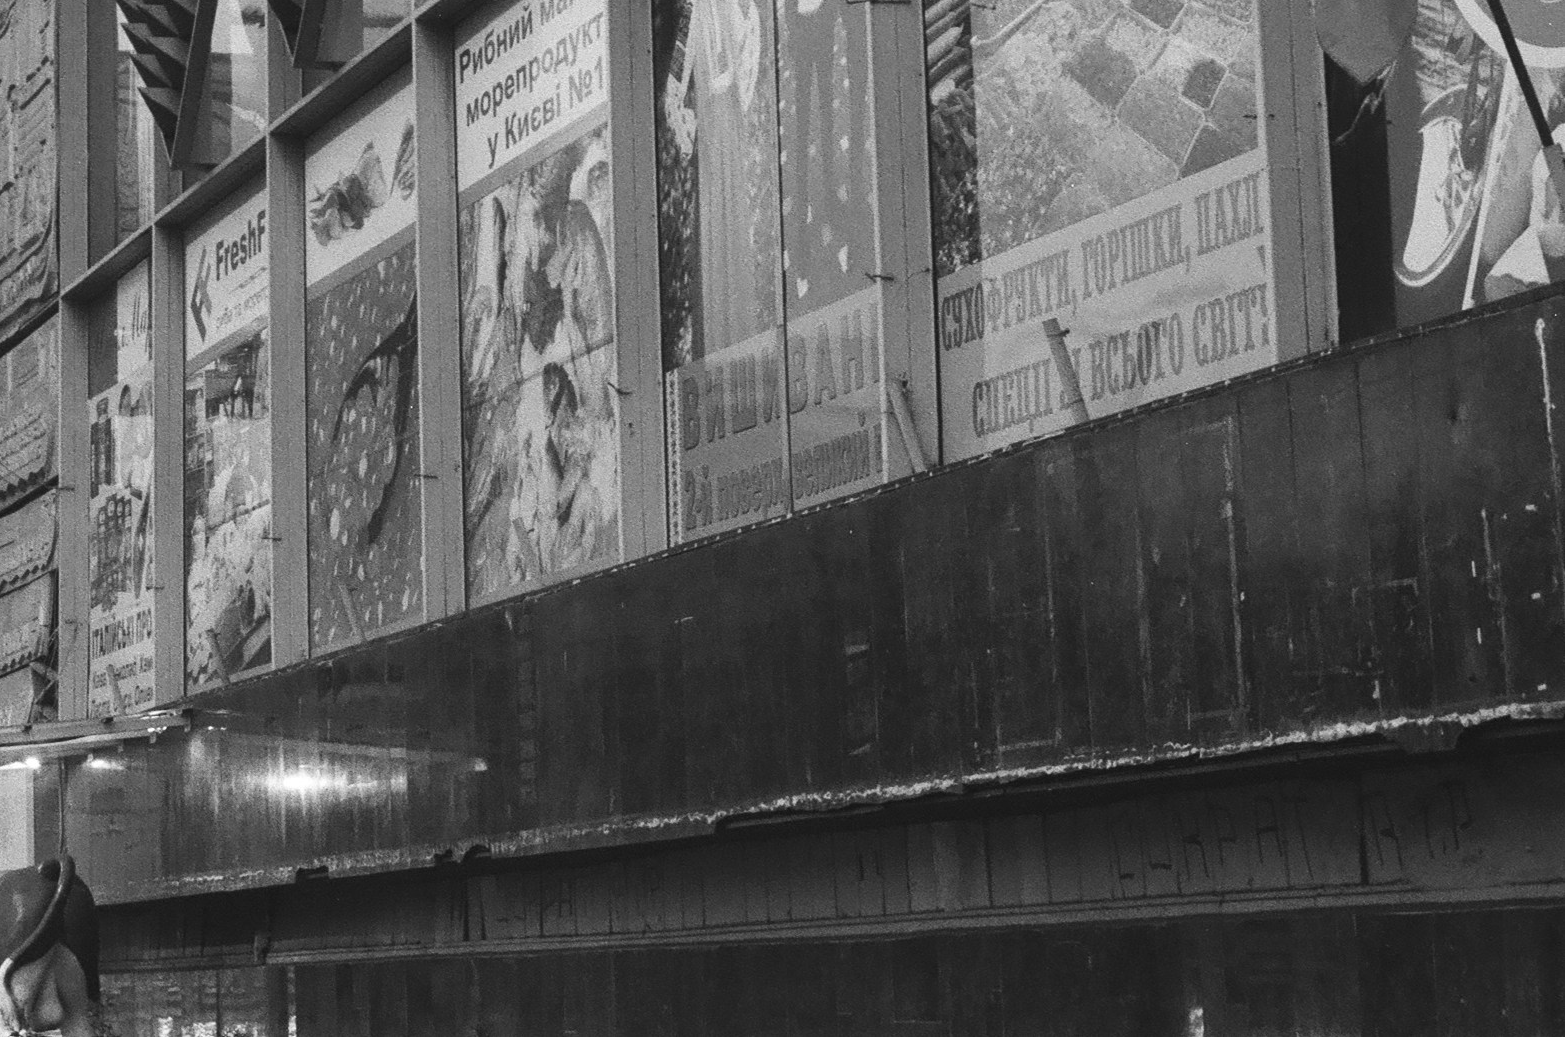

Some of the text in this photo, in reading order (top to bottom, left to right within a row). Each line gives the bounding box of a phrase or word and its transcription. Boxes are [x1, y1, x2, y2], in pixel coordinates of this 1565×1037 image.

[459, 3, 533, 84] Рибний
[466, 12, 604, 127] морепродукт
[487, 132, 499, 170] у
[504, 82, 561, 150] Києві
[942, 249, 1078, 352] СУХОФРУКТИ,
[1081, 202, 1191, 301] ГОРІШКИ,
[1090, 312, 1184, 403] ВСЬОГО
